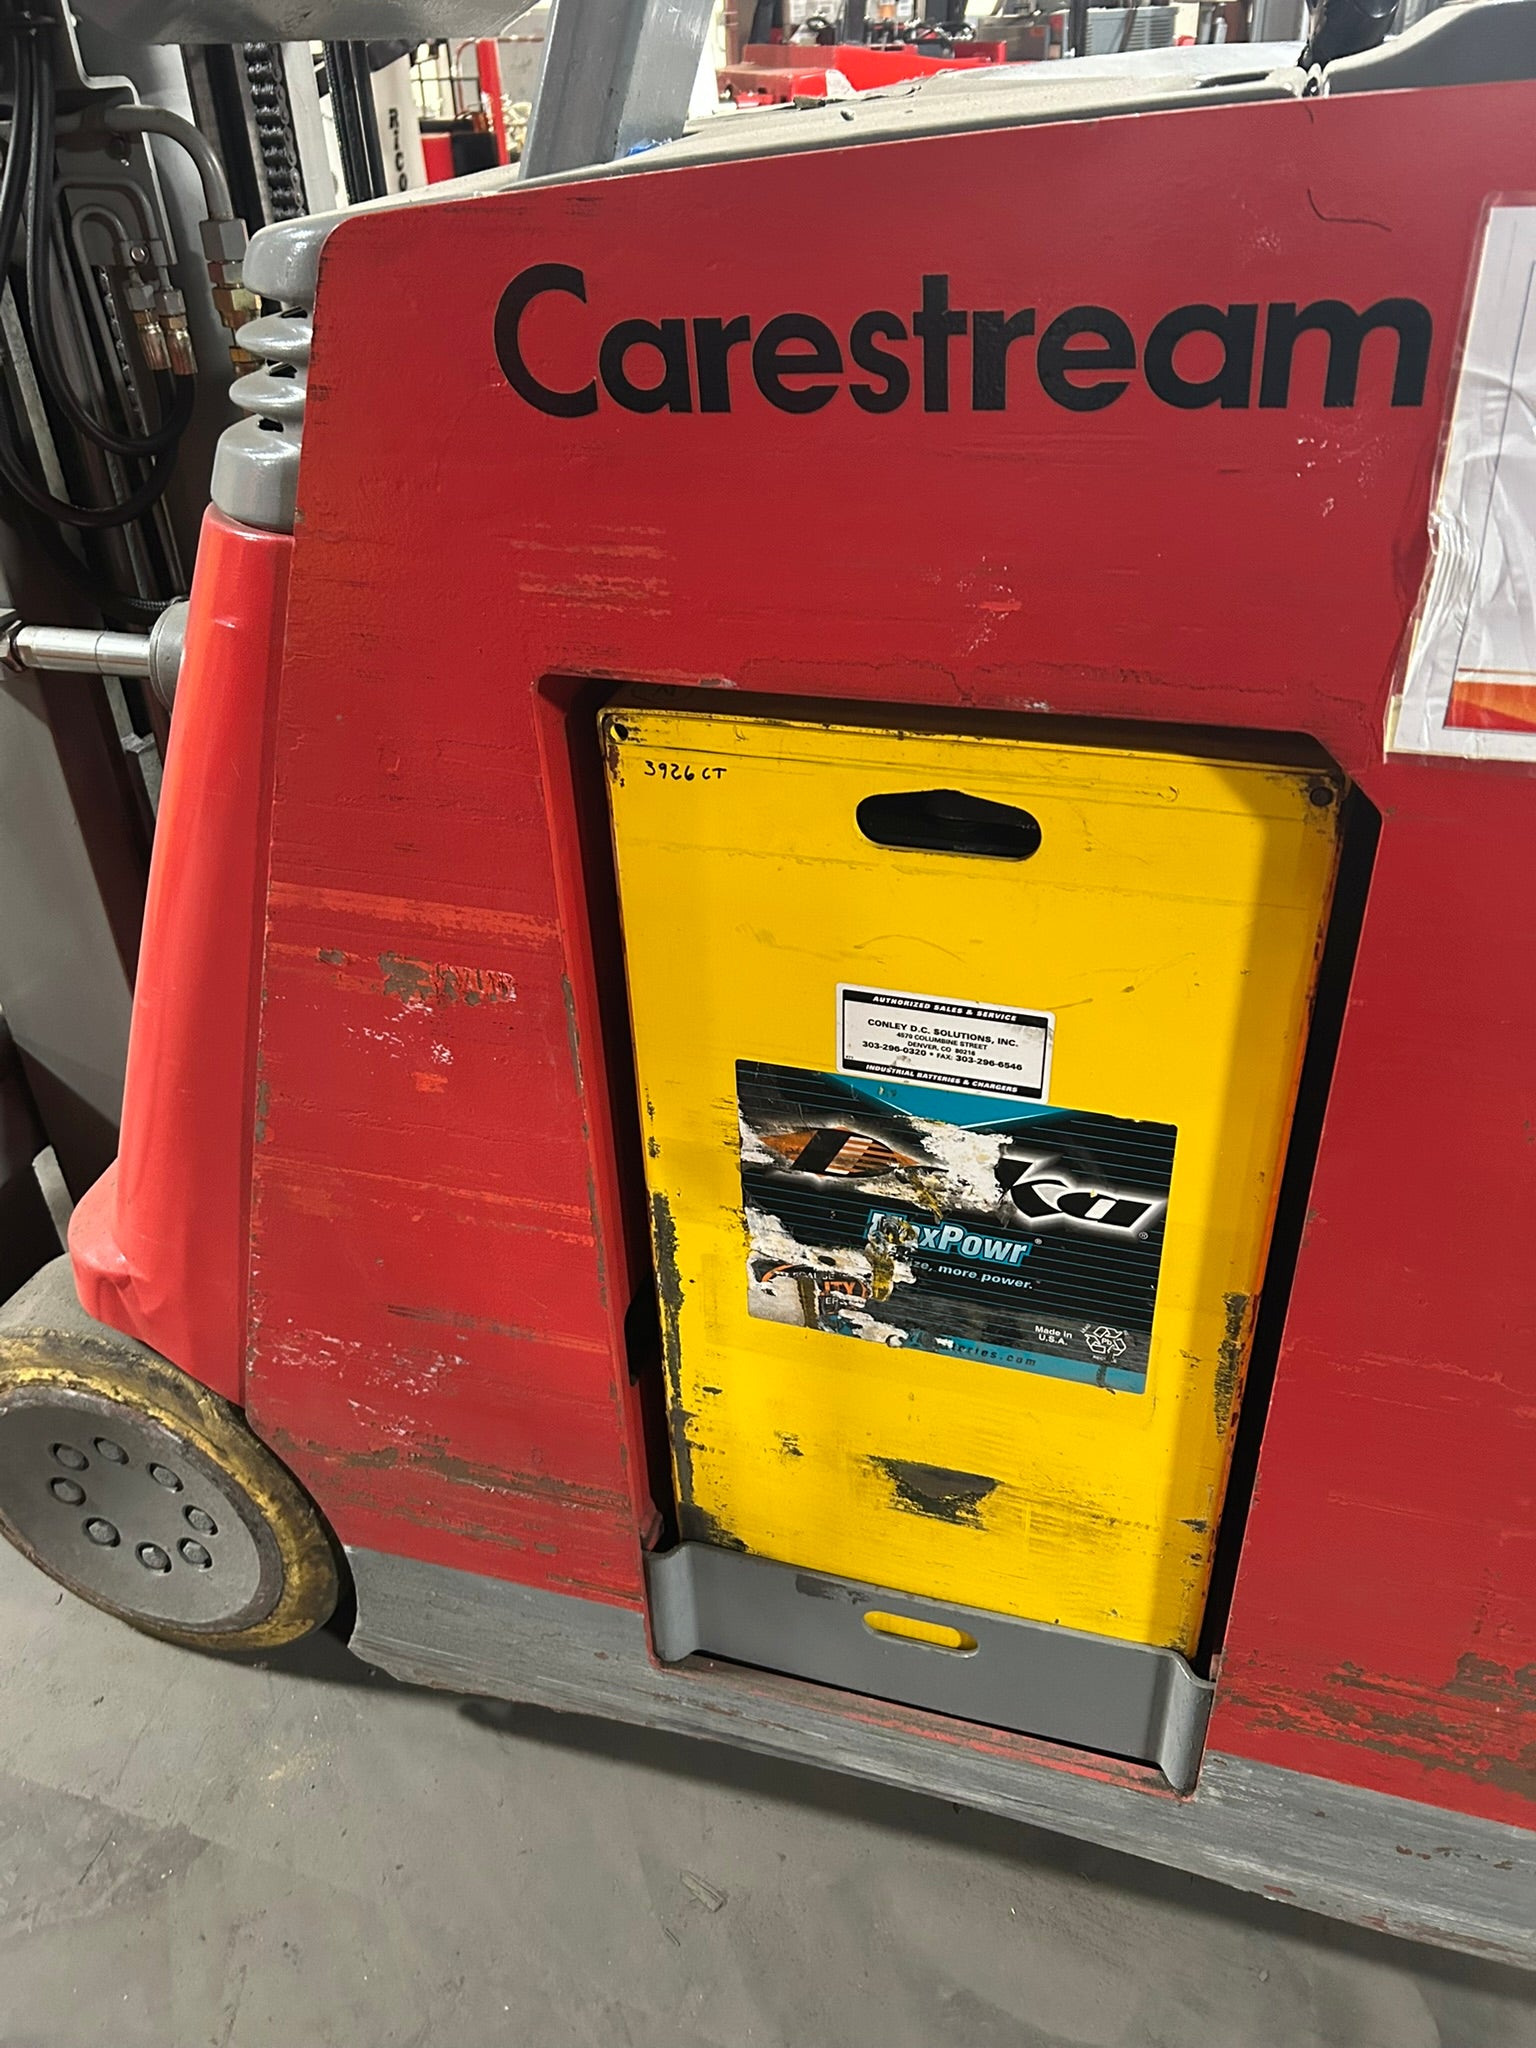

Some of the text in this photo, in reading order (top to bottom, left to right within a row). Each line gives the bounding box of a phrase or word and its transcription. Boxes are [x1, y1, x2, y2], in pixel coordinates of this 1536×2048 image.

[493, 262, 1433, 418] Carestream
[644, 760, 727, 781] 3926 CT
[872, 996, 1017, 1022] AUTHORIZED SALES & SERVICE
[867, 1018, 1019, 1048] CONLEY D.C. SOLUTIONS, INC.
[914, 1034, 958, 1046] COLUMBINE
[959, 1041, 988, 1051] STREET
[862, 1040, 1023, 1071] 303-296-0320 FAX: 303-296-6546
[907, 1040, 939, 1052] DENVER,
[940, 1045, 952, 1053] CO
[865, 1064, 1018, 1093] INDUSTRIAL BATTERIES & CHARGERS
[938, 1264, 977, 1280] more
[980, 1273, 1033, 1290] power.
[1035, 1325, 1073, 1339] Made in
[1038, 1333, 1068, 1346] U.S.A.
